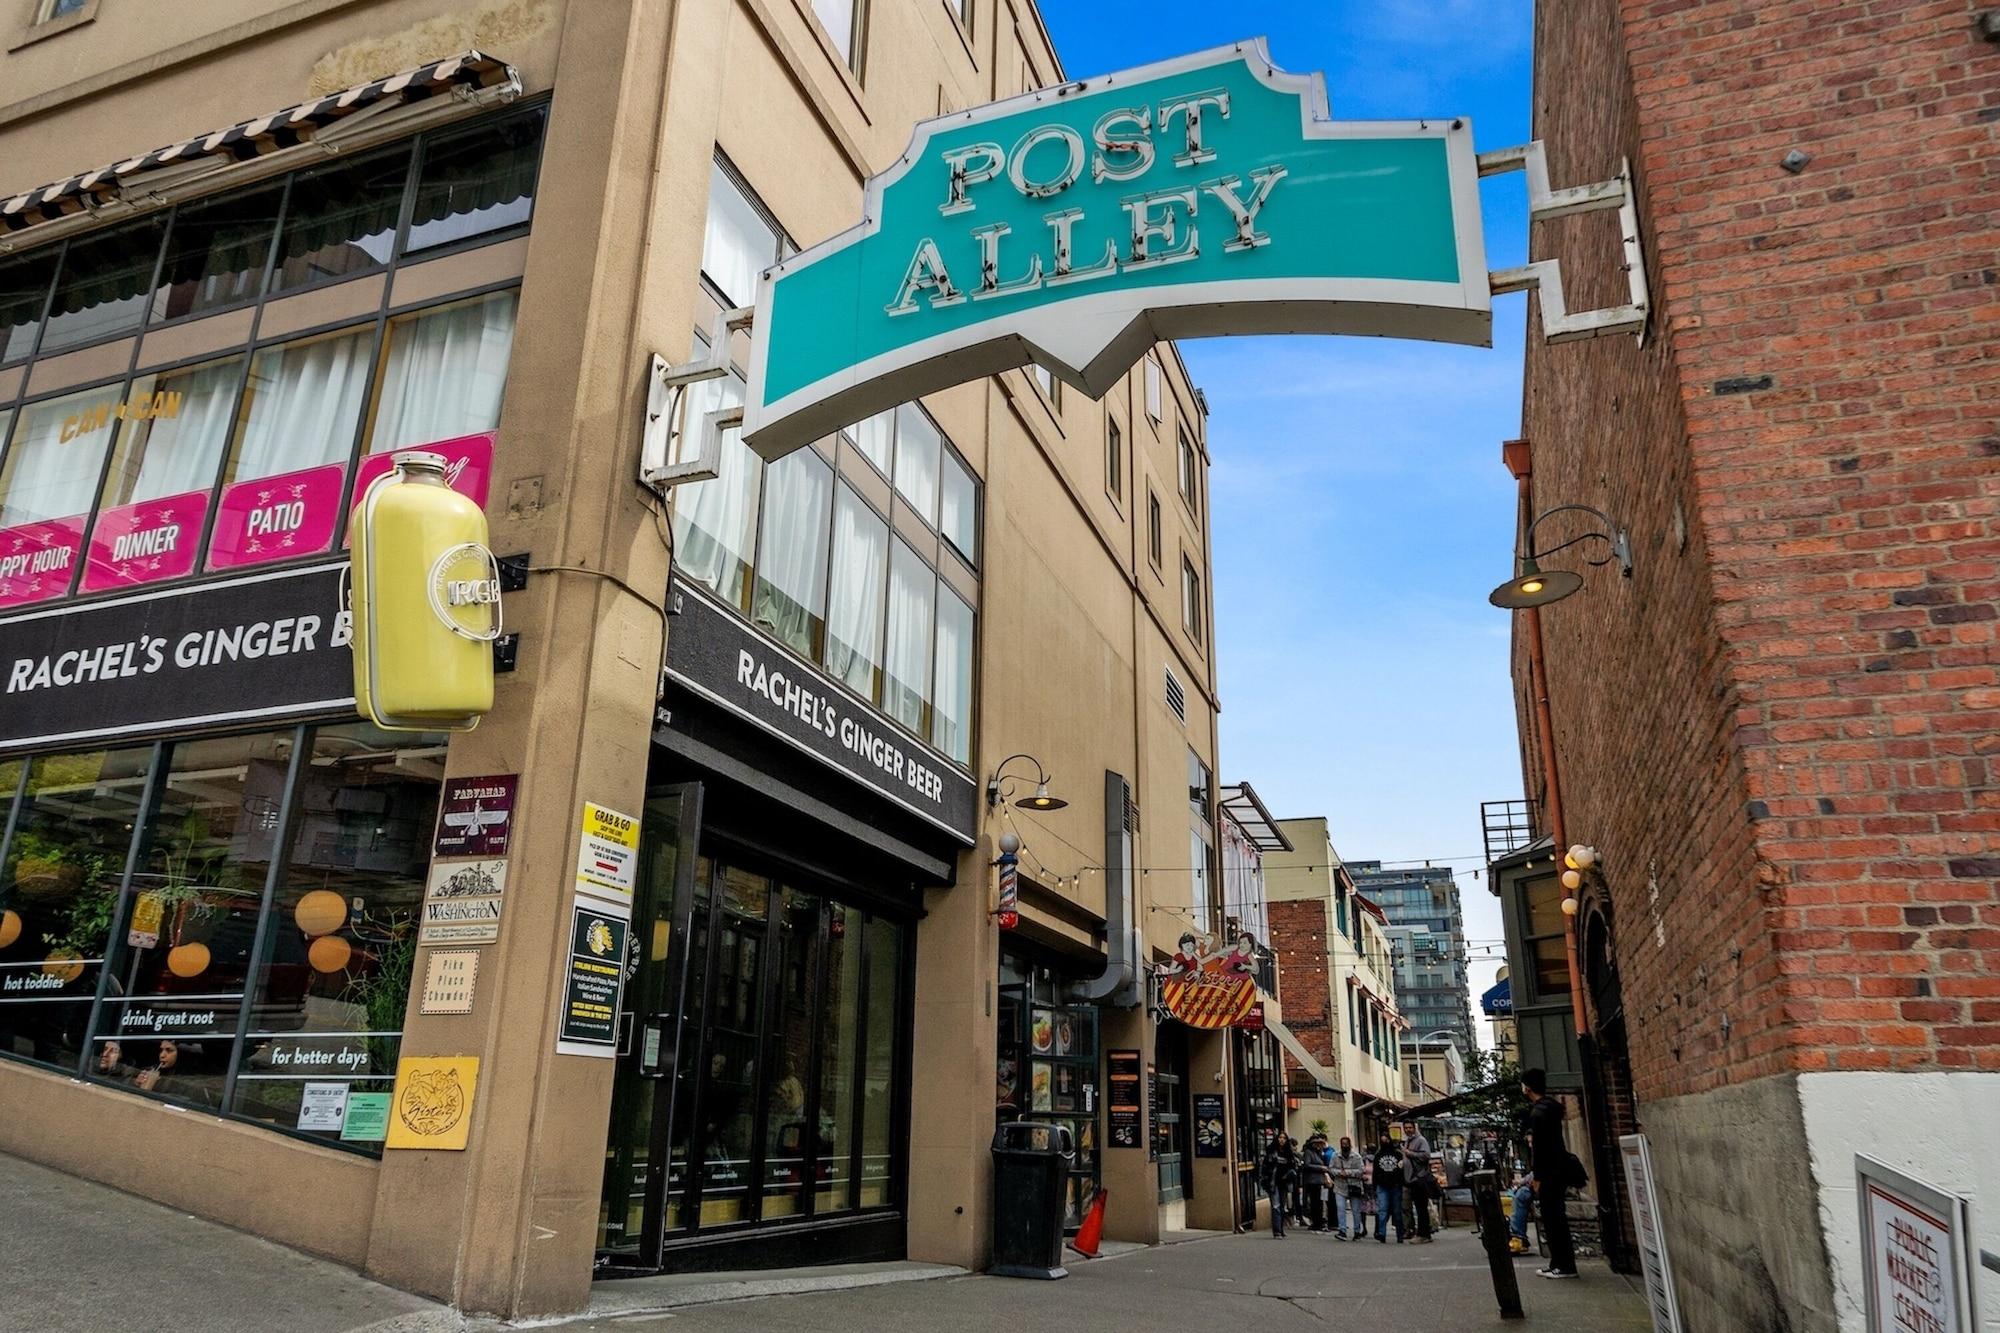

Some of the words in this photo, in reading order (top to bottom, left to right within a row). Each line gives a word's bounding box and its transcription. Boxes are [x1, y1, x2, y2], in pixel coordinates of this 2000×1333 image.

[939, 87, 1231, 217] POST
[884, 164, 1289, 317] ALLEY
[59, 402, 111, 444] CAN
[134, 391, 182, 419] CAN
[247, 501, 305, 537] PATIO
[112, 525, 179, 563] DINNER
[0, 553, 32, 579] PPY
[31, 546, 72, 574] HOUR
[6, 635, 168, 693] RACHEL'S
[174, 614, 321, 669] GINGER
[737, 649, 837, 738] RACHEL'S
[840, 718, 904, 781] GINGER
[907, 758, 943, 803] BEER
[594, 810, 613, 825] GRAB
[613, 816, 620, 828] &
[620, 819, 631, 831] GO
[428, 900, 501, 920] WASHINGTON
[438, 975, 464, 985] Place
[443, 960, 463, 970] Pike
[4, 976, 22, 990] hot
[24, 975, 64, 990] toddies
[428, 990, 469, 1001] Chowder
[1492, 999, 1512, 1007] COP
[121, 1009, 154, 1026] drink
[155, 1013, 187, 1031] great
[188, 1011, 215, 1025] root
[271, 1047, 292, 1065] for
[293, 1047, 335, 1065] better
[337, 1047, 368, 1072] days
[1893, 1216, 1935, 1267] PUBLIC
[1886, 1248, 1929, 1300] MARKET
